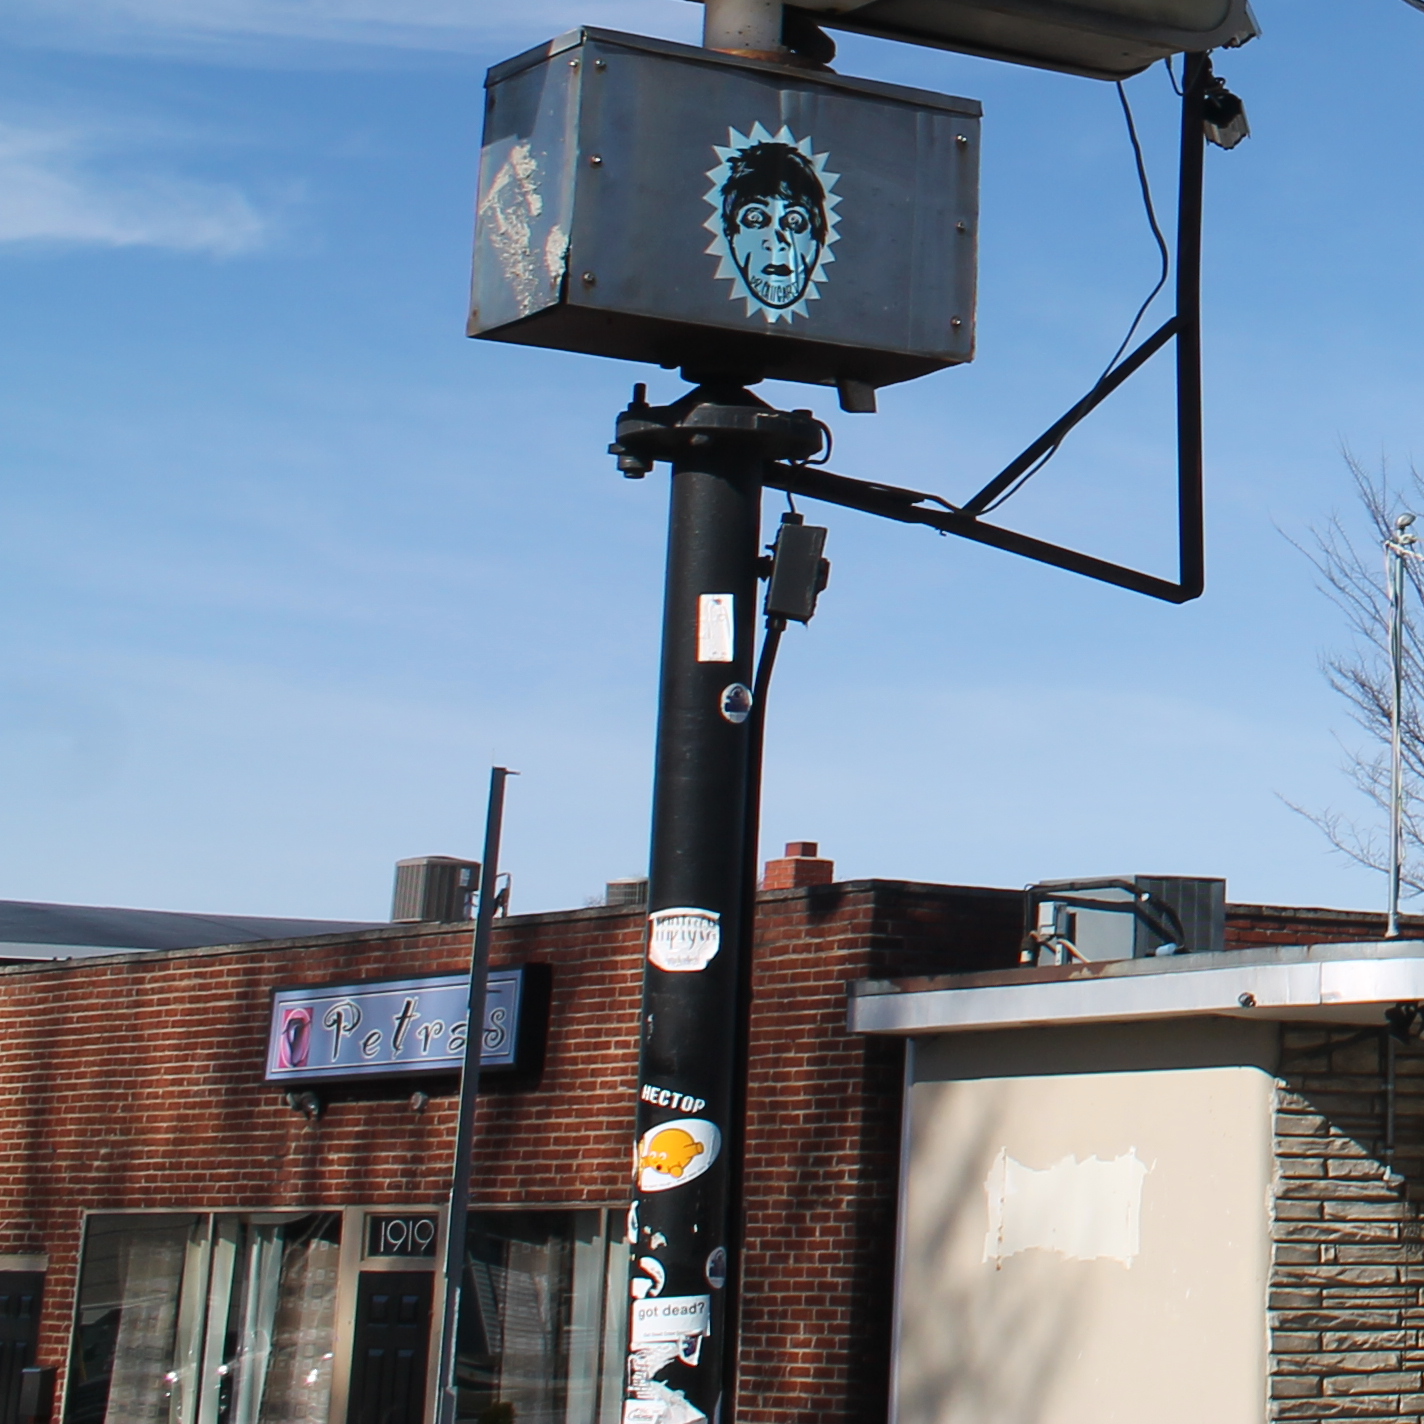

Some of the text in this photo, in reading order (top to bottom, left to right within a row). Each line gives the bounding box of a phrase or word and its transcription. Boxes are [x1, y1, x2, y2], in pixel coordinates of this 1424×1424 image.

[380, 1219, 435, 1253] 1919
[638, 1301, 705, 1321] got dead?
